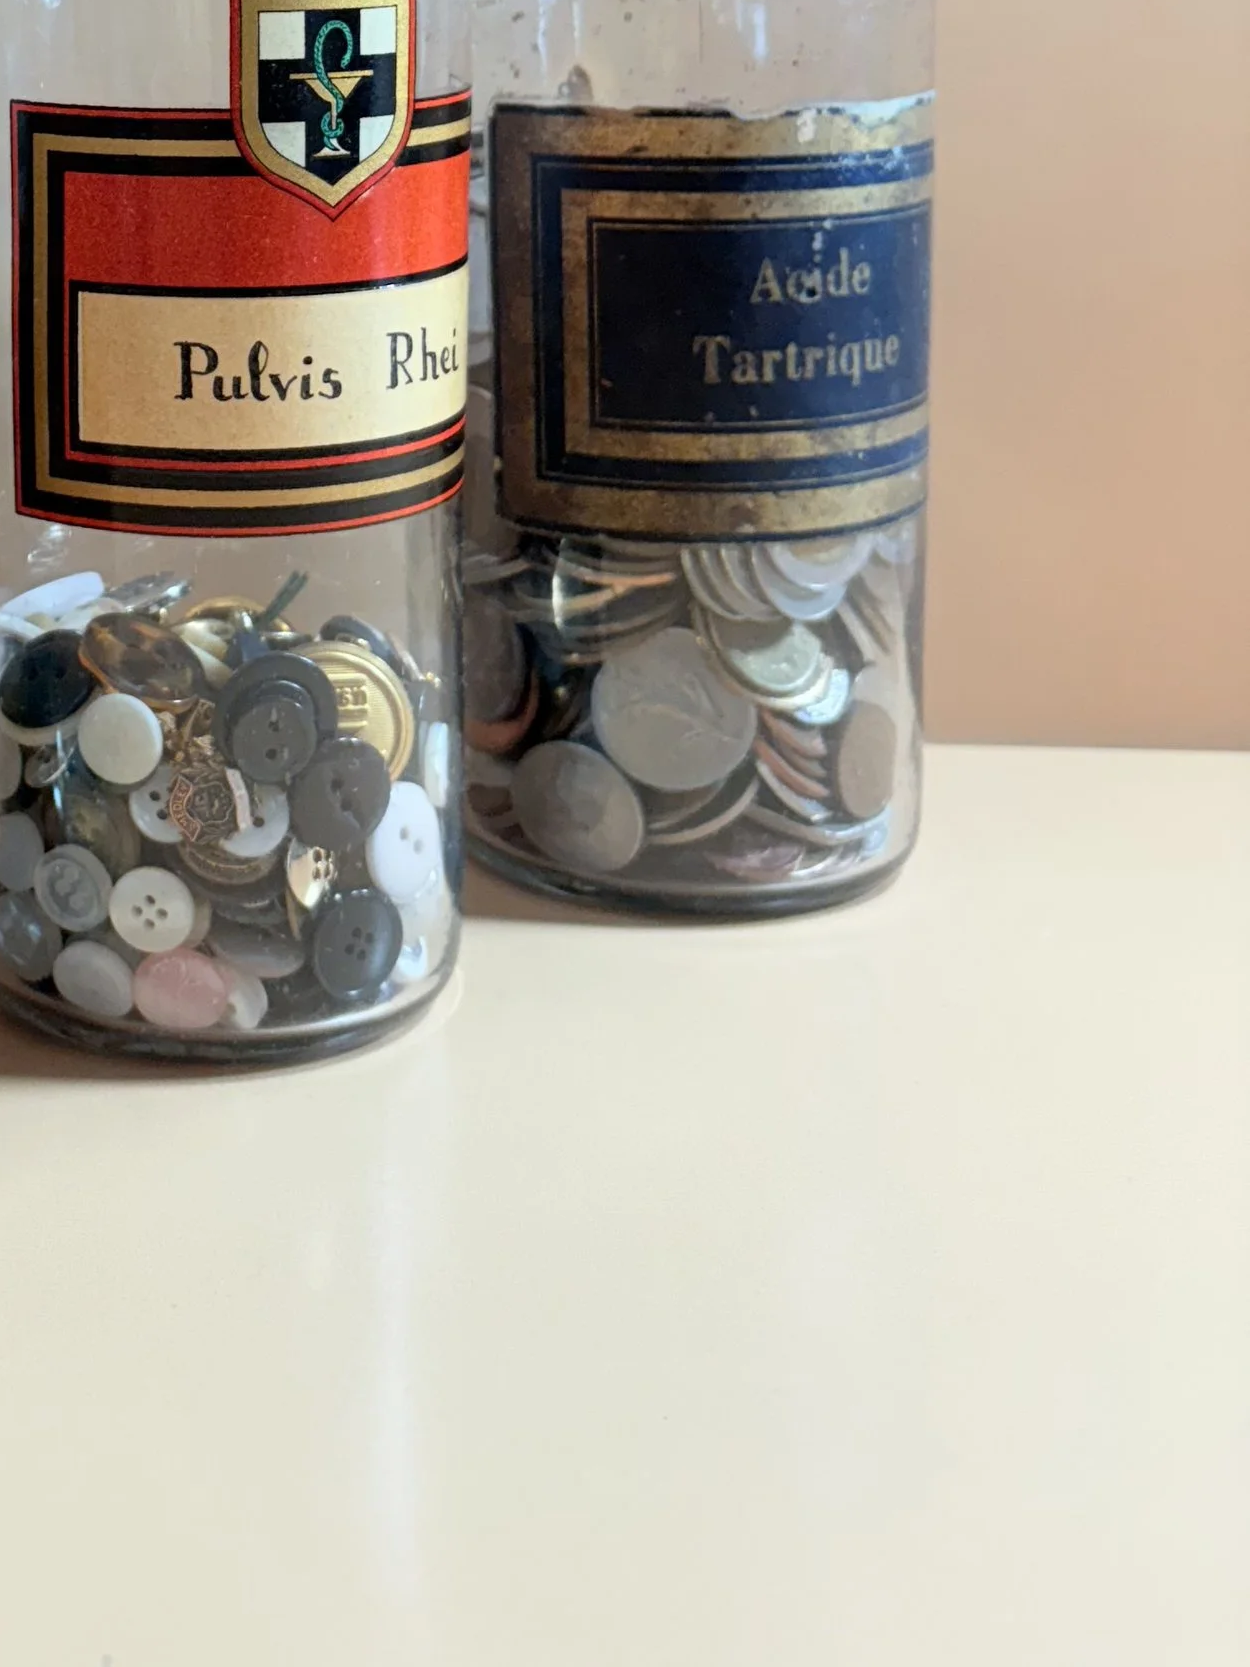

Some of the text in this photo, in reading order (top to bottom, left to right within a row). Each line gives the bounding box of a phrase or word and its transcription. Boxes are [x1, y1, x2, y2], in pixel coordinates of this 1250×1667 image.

[173, 327, 459, 401] Pulvis Rhei
[692, 333, 899, 387] Tartrique
